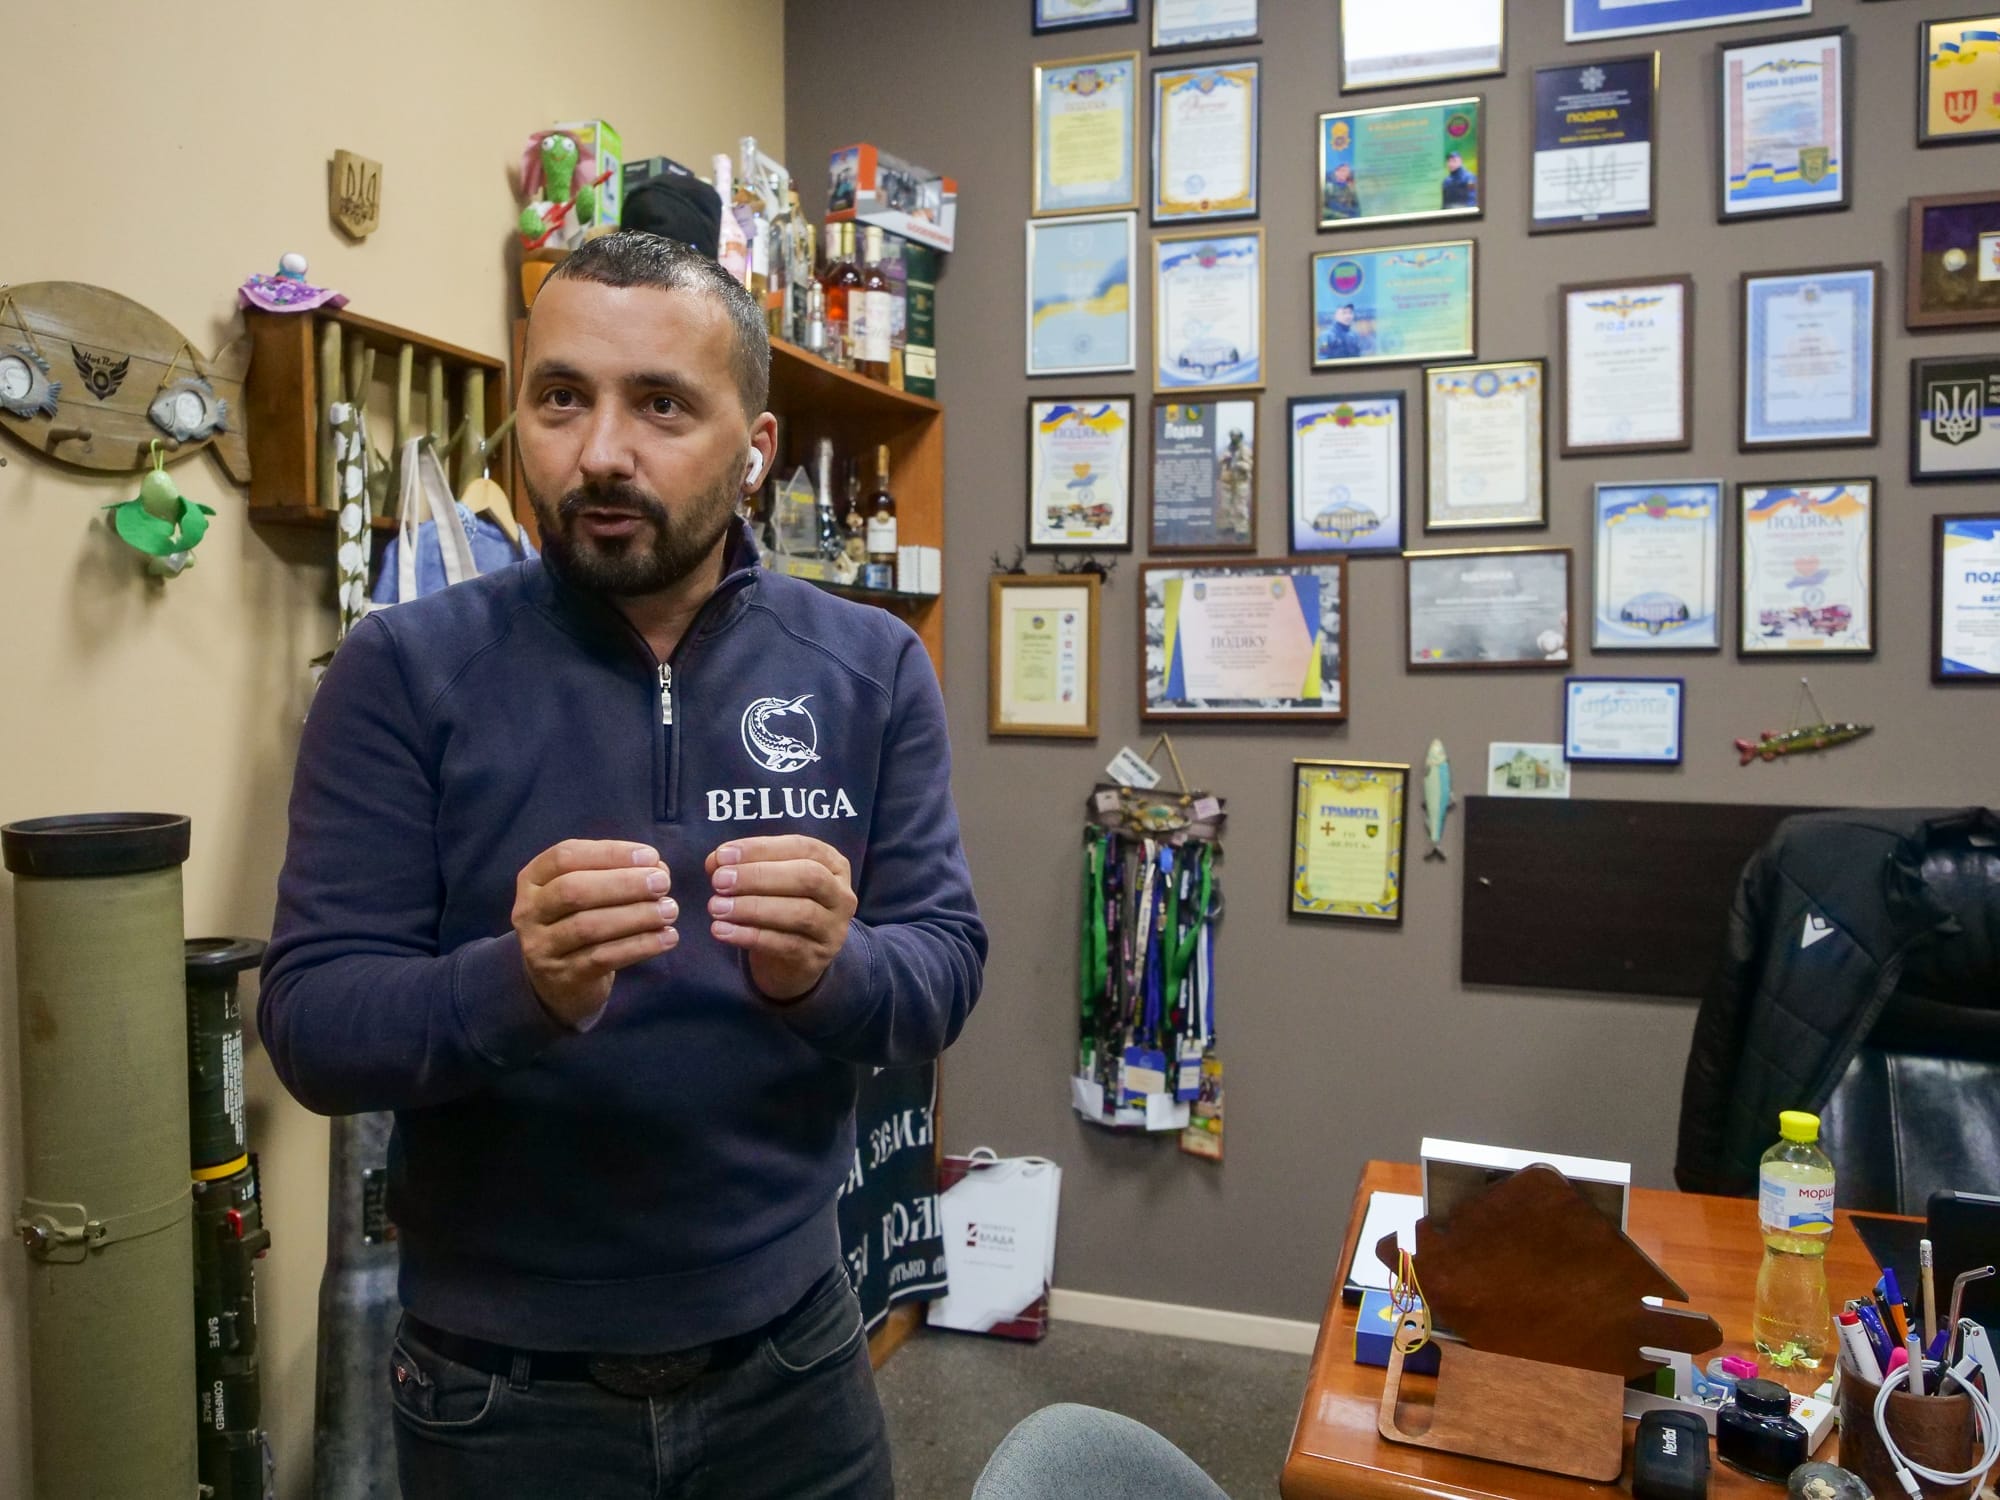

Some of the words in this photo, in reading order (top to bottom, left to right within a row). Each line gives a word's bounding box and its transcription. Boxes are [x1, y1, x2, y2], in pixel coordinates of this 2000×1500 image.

[1594, 318, 1655, 332] ПОДЯКА
[1767, 515, 1842, 530] ПОДЯКА
[1210, 636, 1267, 650] ПОДЯКУ
[706, 788, 857, 821] BELUGA
[1319, 804, 1379, 820] ГРАМОТА
[208, 1316, 220, 1348] SAFE
[204, 1391, 213, 1424] SPACE
[215, 1381, 225, 1430] CONFINED
